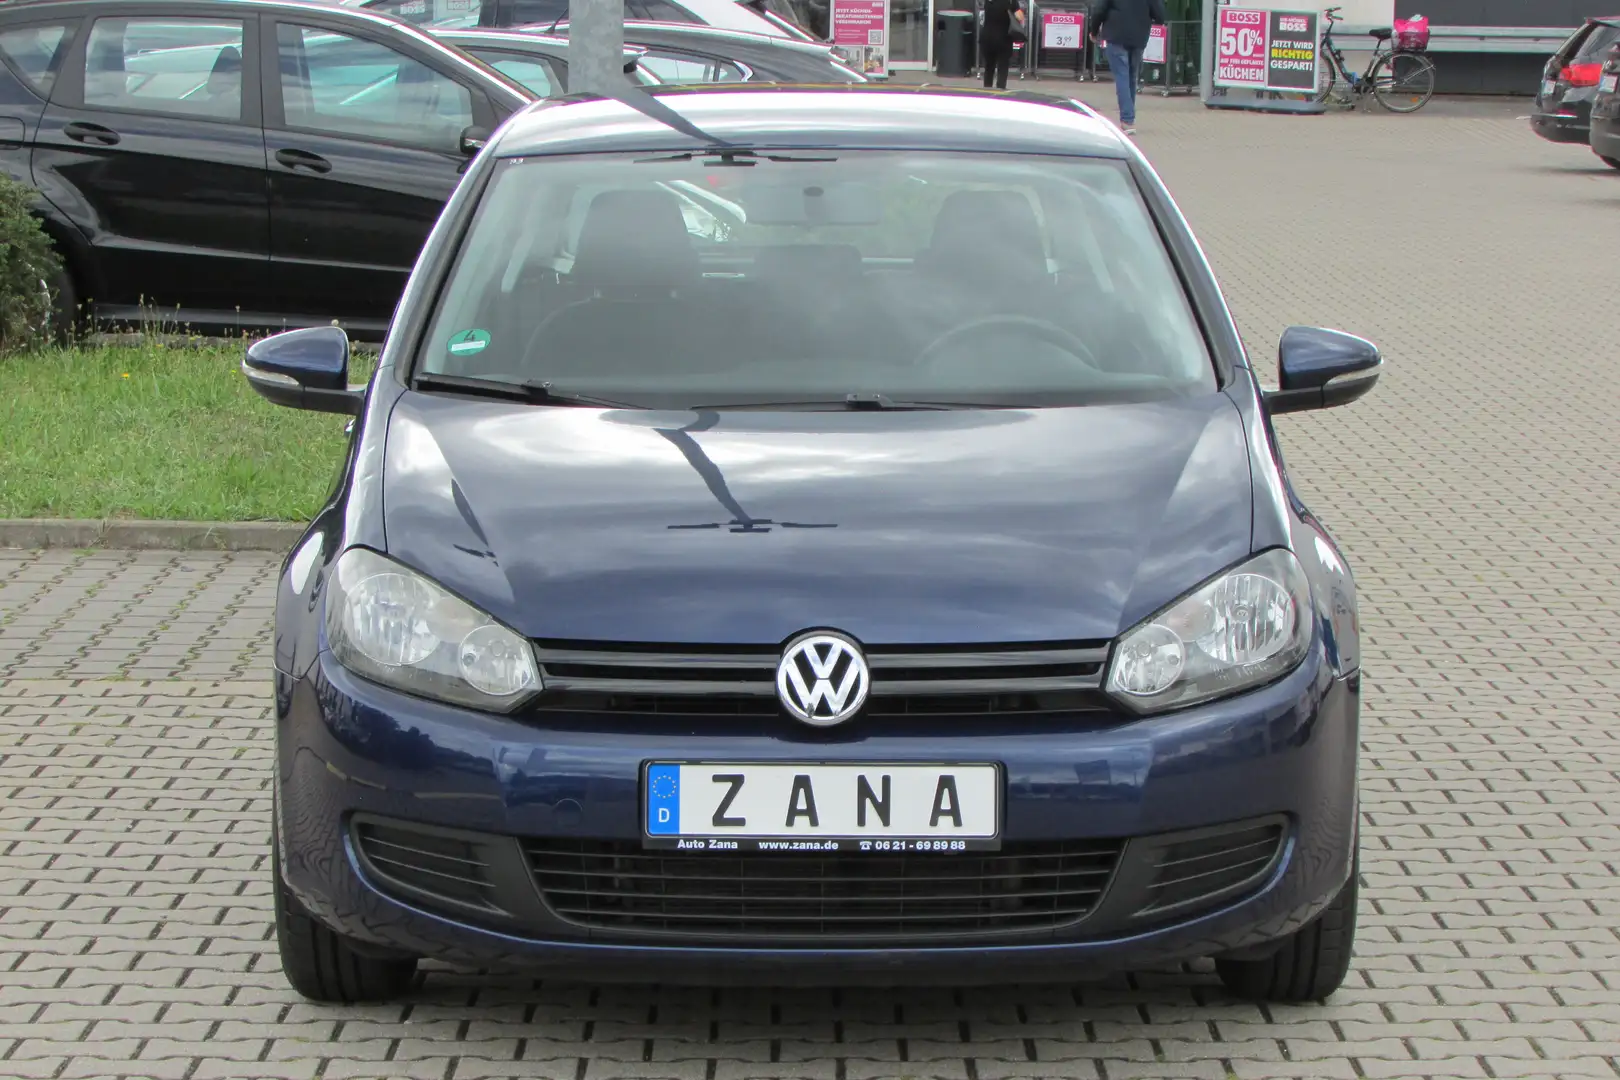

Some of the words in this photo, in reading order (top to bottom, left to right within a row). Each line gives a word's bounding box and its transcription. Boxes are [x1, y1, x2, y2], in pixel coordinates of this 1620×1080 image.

[1227, 12, 1260, 23] BOSS
[1279, 22, 1307, 32] BOSS
[1220, 27, 1263, 57] 50%
[1271, 40, 1291, 48] JETZT
[1293, 41, 1314, 50] WIRD
[1271, 48, 1314, 60] RICHTIG
[1270, 60, 1313, 71] GESPART!
[1219, 64, 1264, 81] KÜCHEN
[657, 808, 671, 823] D
[677, 839, 705, 849] Auto
[708, 839, 738, 849] Zana
[758, 840, 839, 850] www.zana.de
